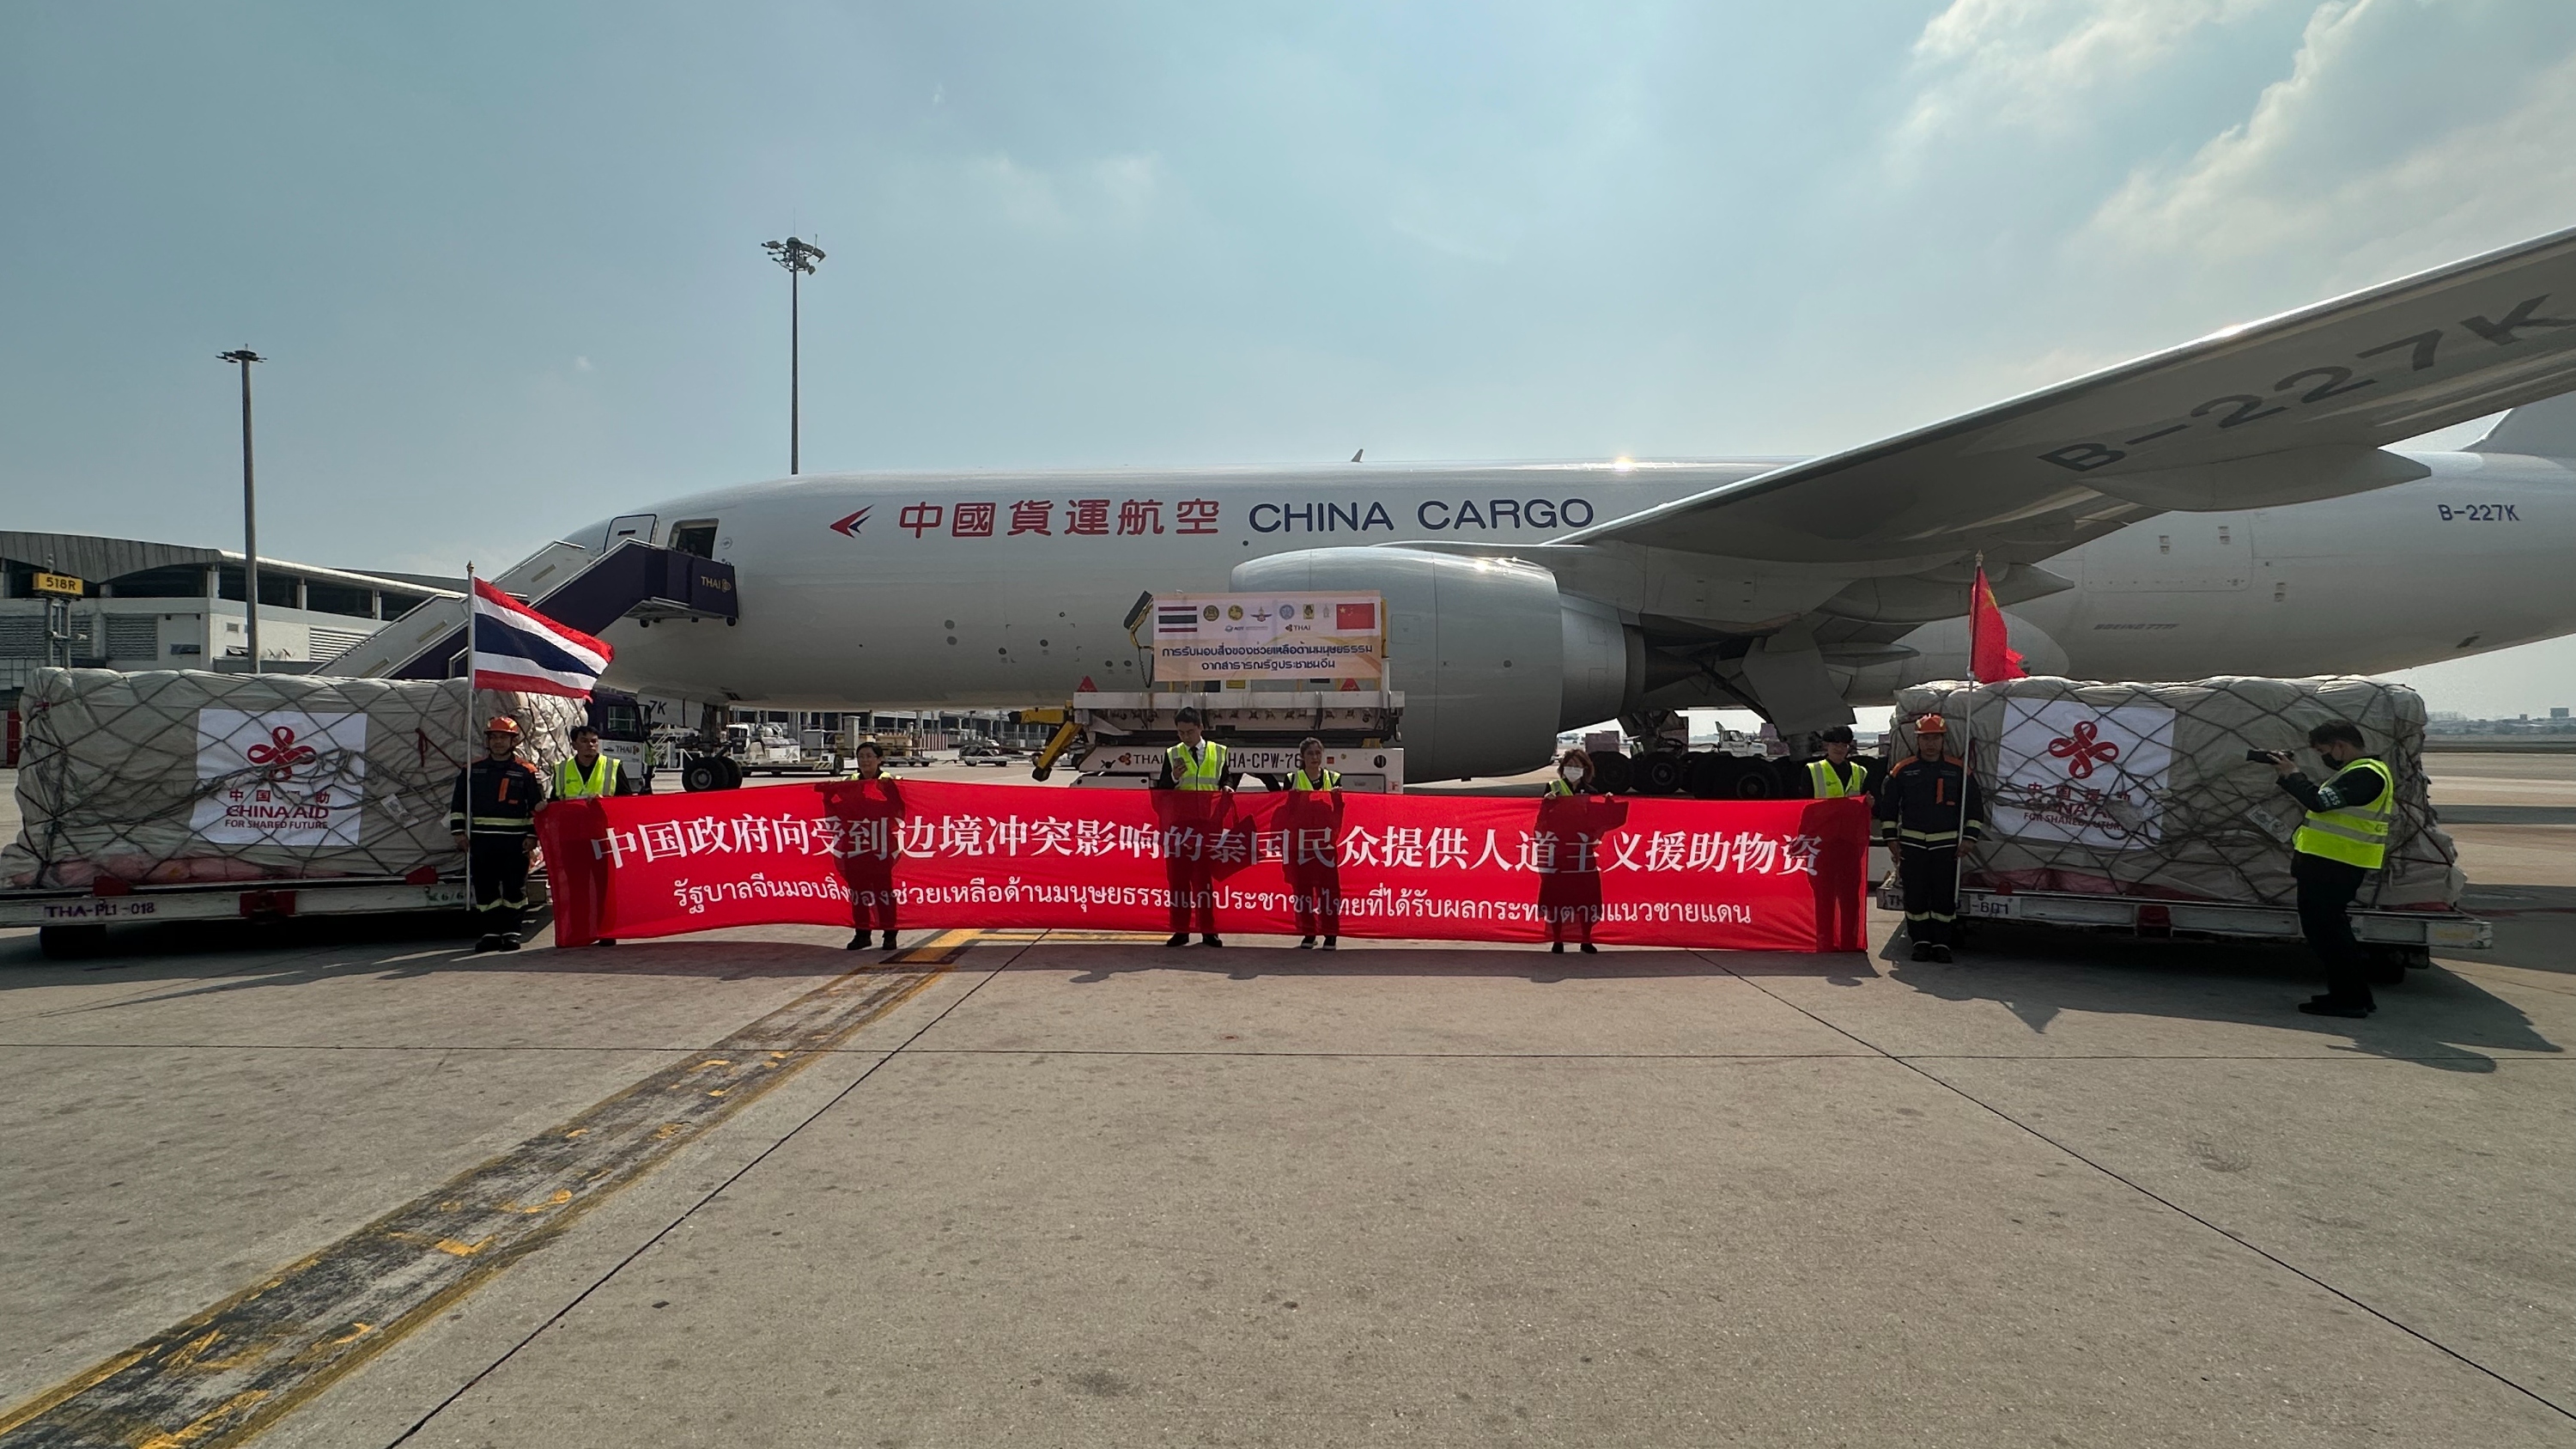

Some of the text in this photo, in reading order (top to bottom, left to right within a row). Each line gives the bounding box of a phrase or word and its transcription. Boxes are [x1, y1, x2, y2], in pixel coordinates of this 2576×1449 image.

[2038, 293, 2576, 472] B-227K
[899, 498, 1219, 539] 中國貨運航空
[1249, 498, 1594, 533] CHINA CARGO
[2437, 504, 2520, 521] B-227K
[46, 576, 76, 591] 518R
[701, 575, 721, 589] THAI
[616, 745, 634, 754] THAI
[1133, 754, 1163, 764] THAI
[1228, 752, 1301, 769] HA-CPW-76
[229, 788, 331, 805] 中国助
[226, 805, 330, 819] CHINA AID
[225, 819, 328, 830] FOR SHARED FUTURE
[592, 813, 1823, 876] 中国政府向受到边境冲突影响的泰国民众提供人道主义援助物资
